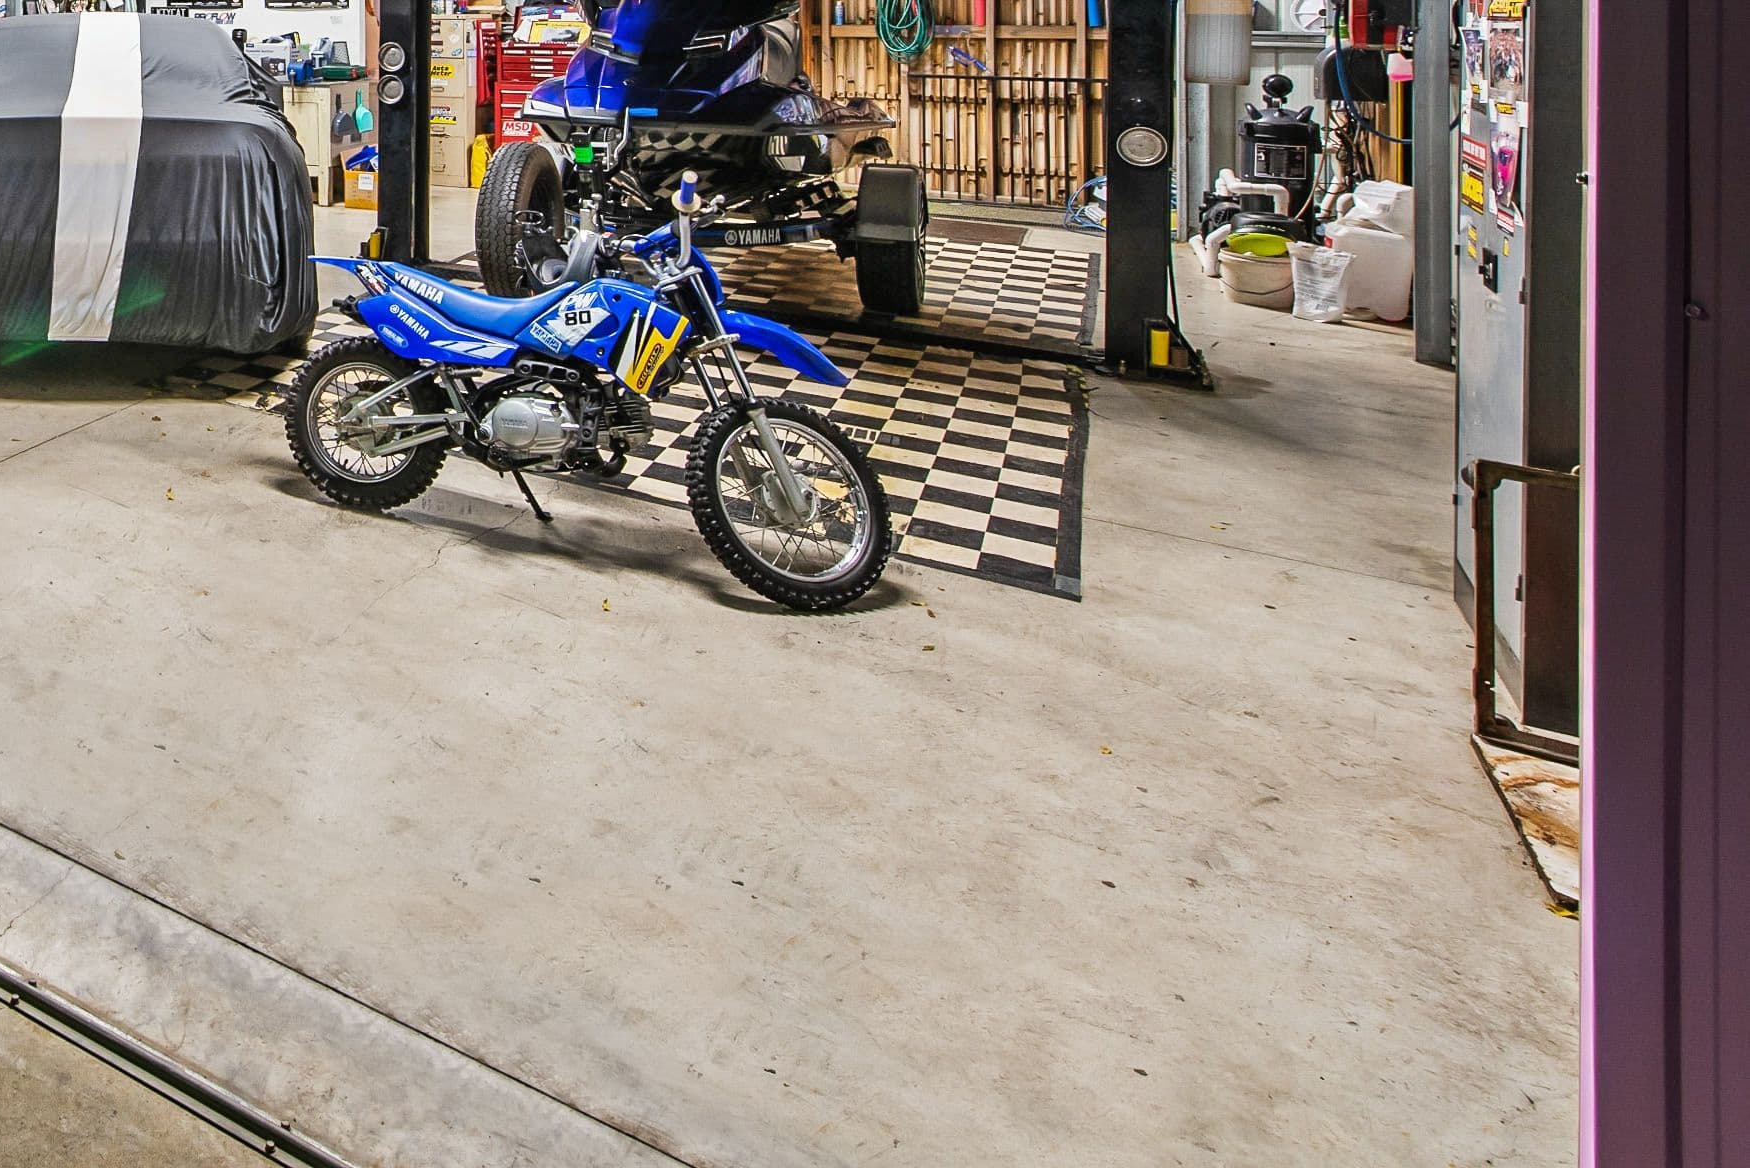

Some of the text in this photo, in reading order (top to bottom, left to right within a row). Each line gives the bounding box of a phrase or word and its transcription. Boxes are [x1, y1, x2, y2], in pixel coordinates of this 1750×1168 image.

[504, 122, 530, 131] MSD
[738, 228, 781, 245] YAMAHA
[394, 271, 444, 305] YAMAHA
[559, 291, 599, 312] PW
[397, 310, 431, 340] YAMAHA
[564, 310, 592, 327] 80
[531, 322, 562, 352] YAMAHA
